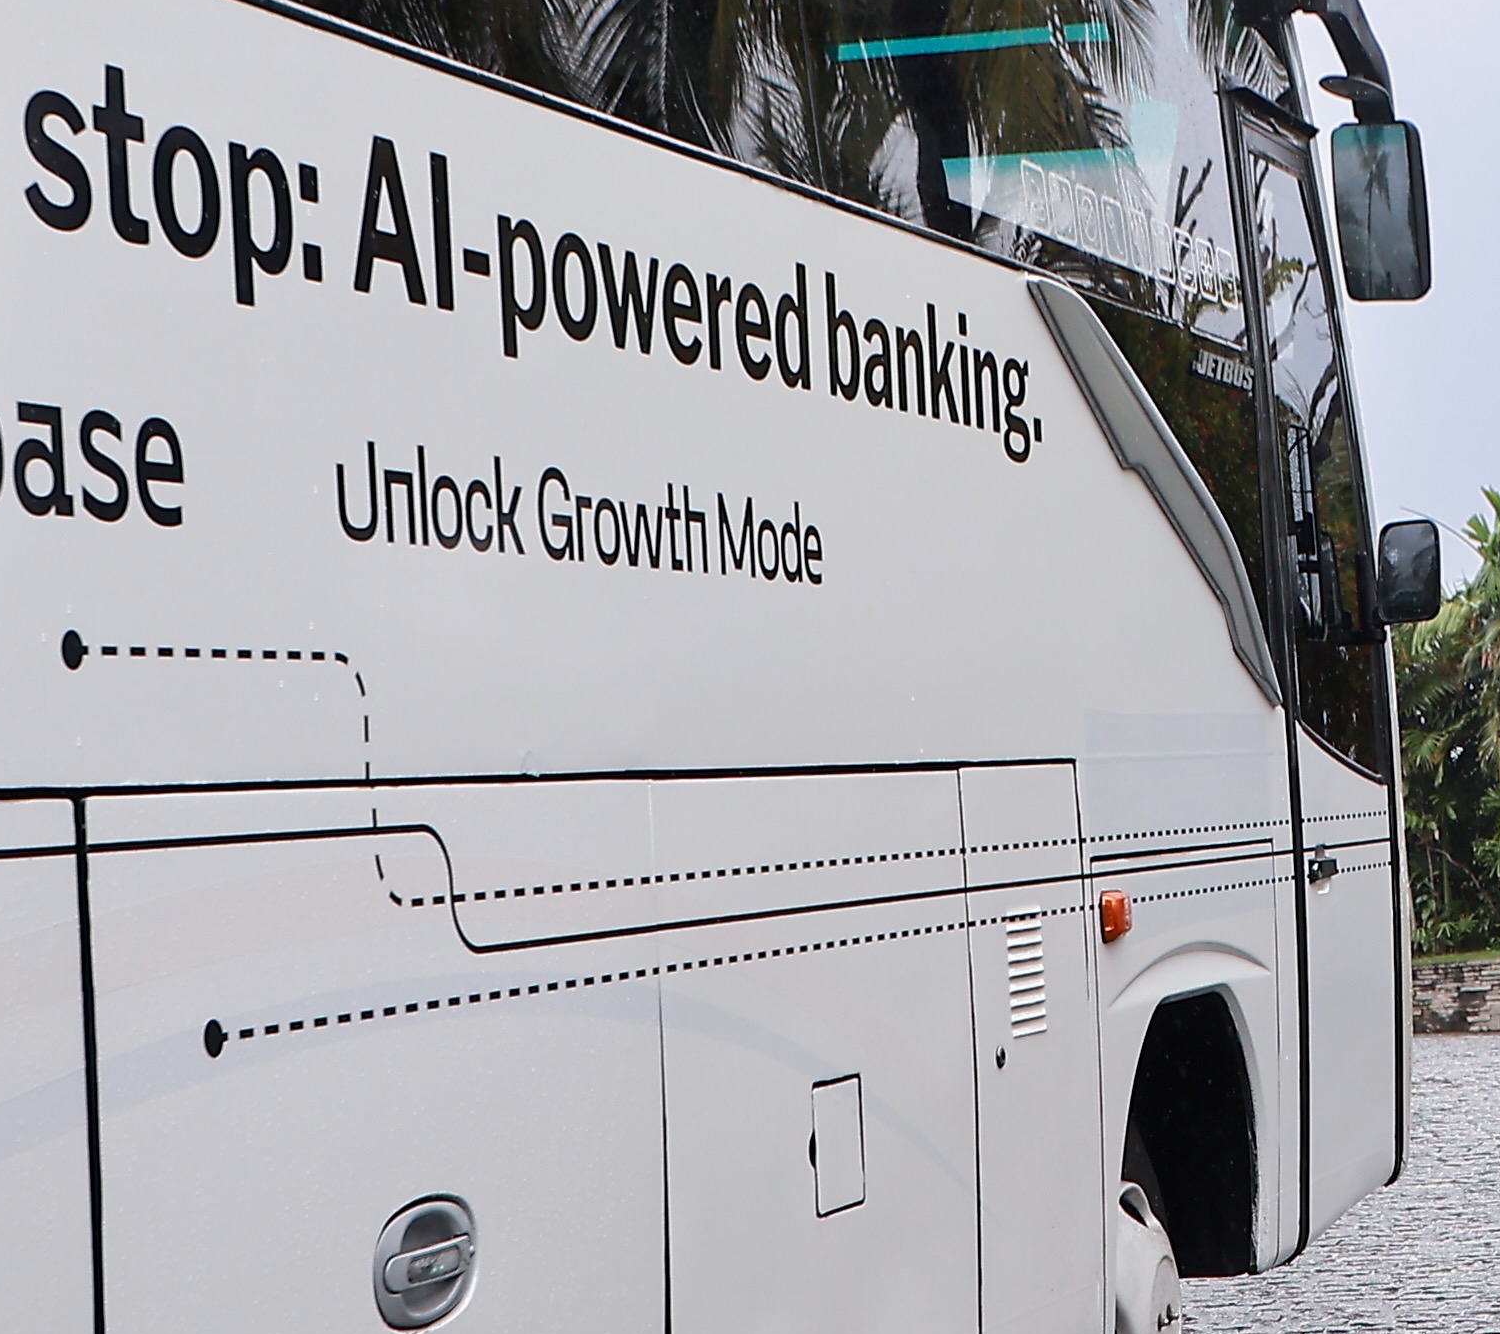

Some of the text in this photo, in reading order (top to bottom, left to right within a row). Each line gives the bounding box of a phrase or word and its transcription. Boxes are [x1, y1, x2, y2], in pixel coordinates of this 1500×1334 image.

[23, 63, 324, 307] stop:
[352, 135, 813, 392] AI-powered
[824, 271, 1045, 465] banking.
[1195, 348, 1255, 392] JETBUS
[335, 440, 824, 587] Unlock Growth Mode
